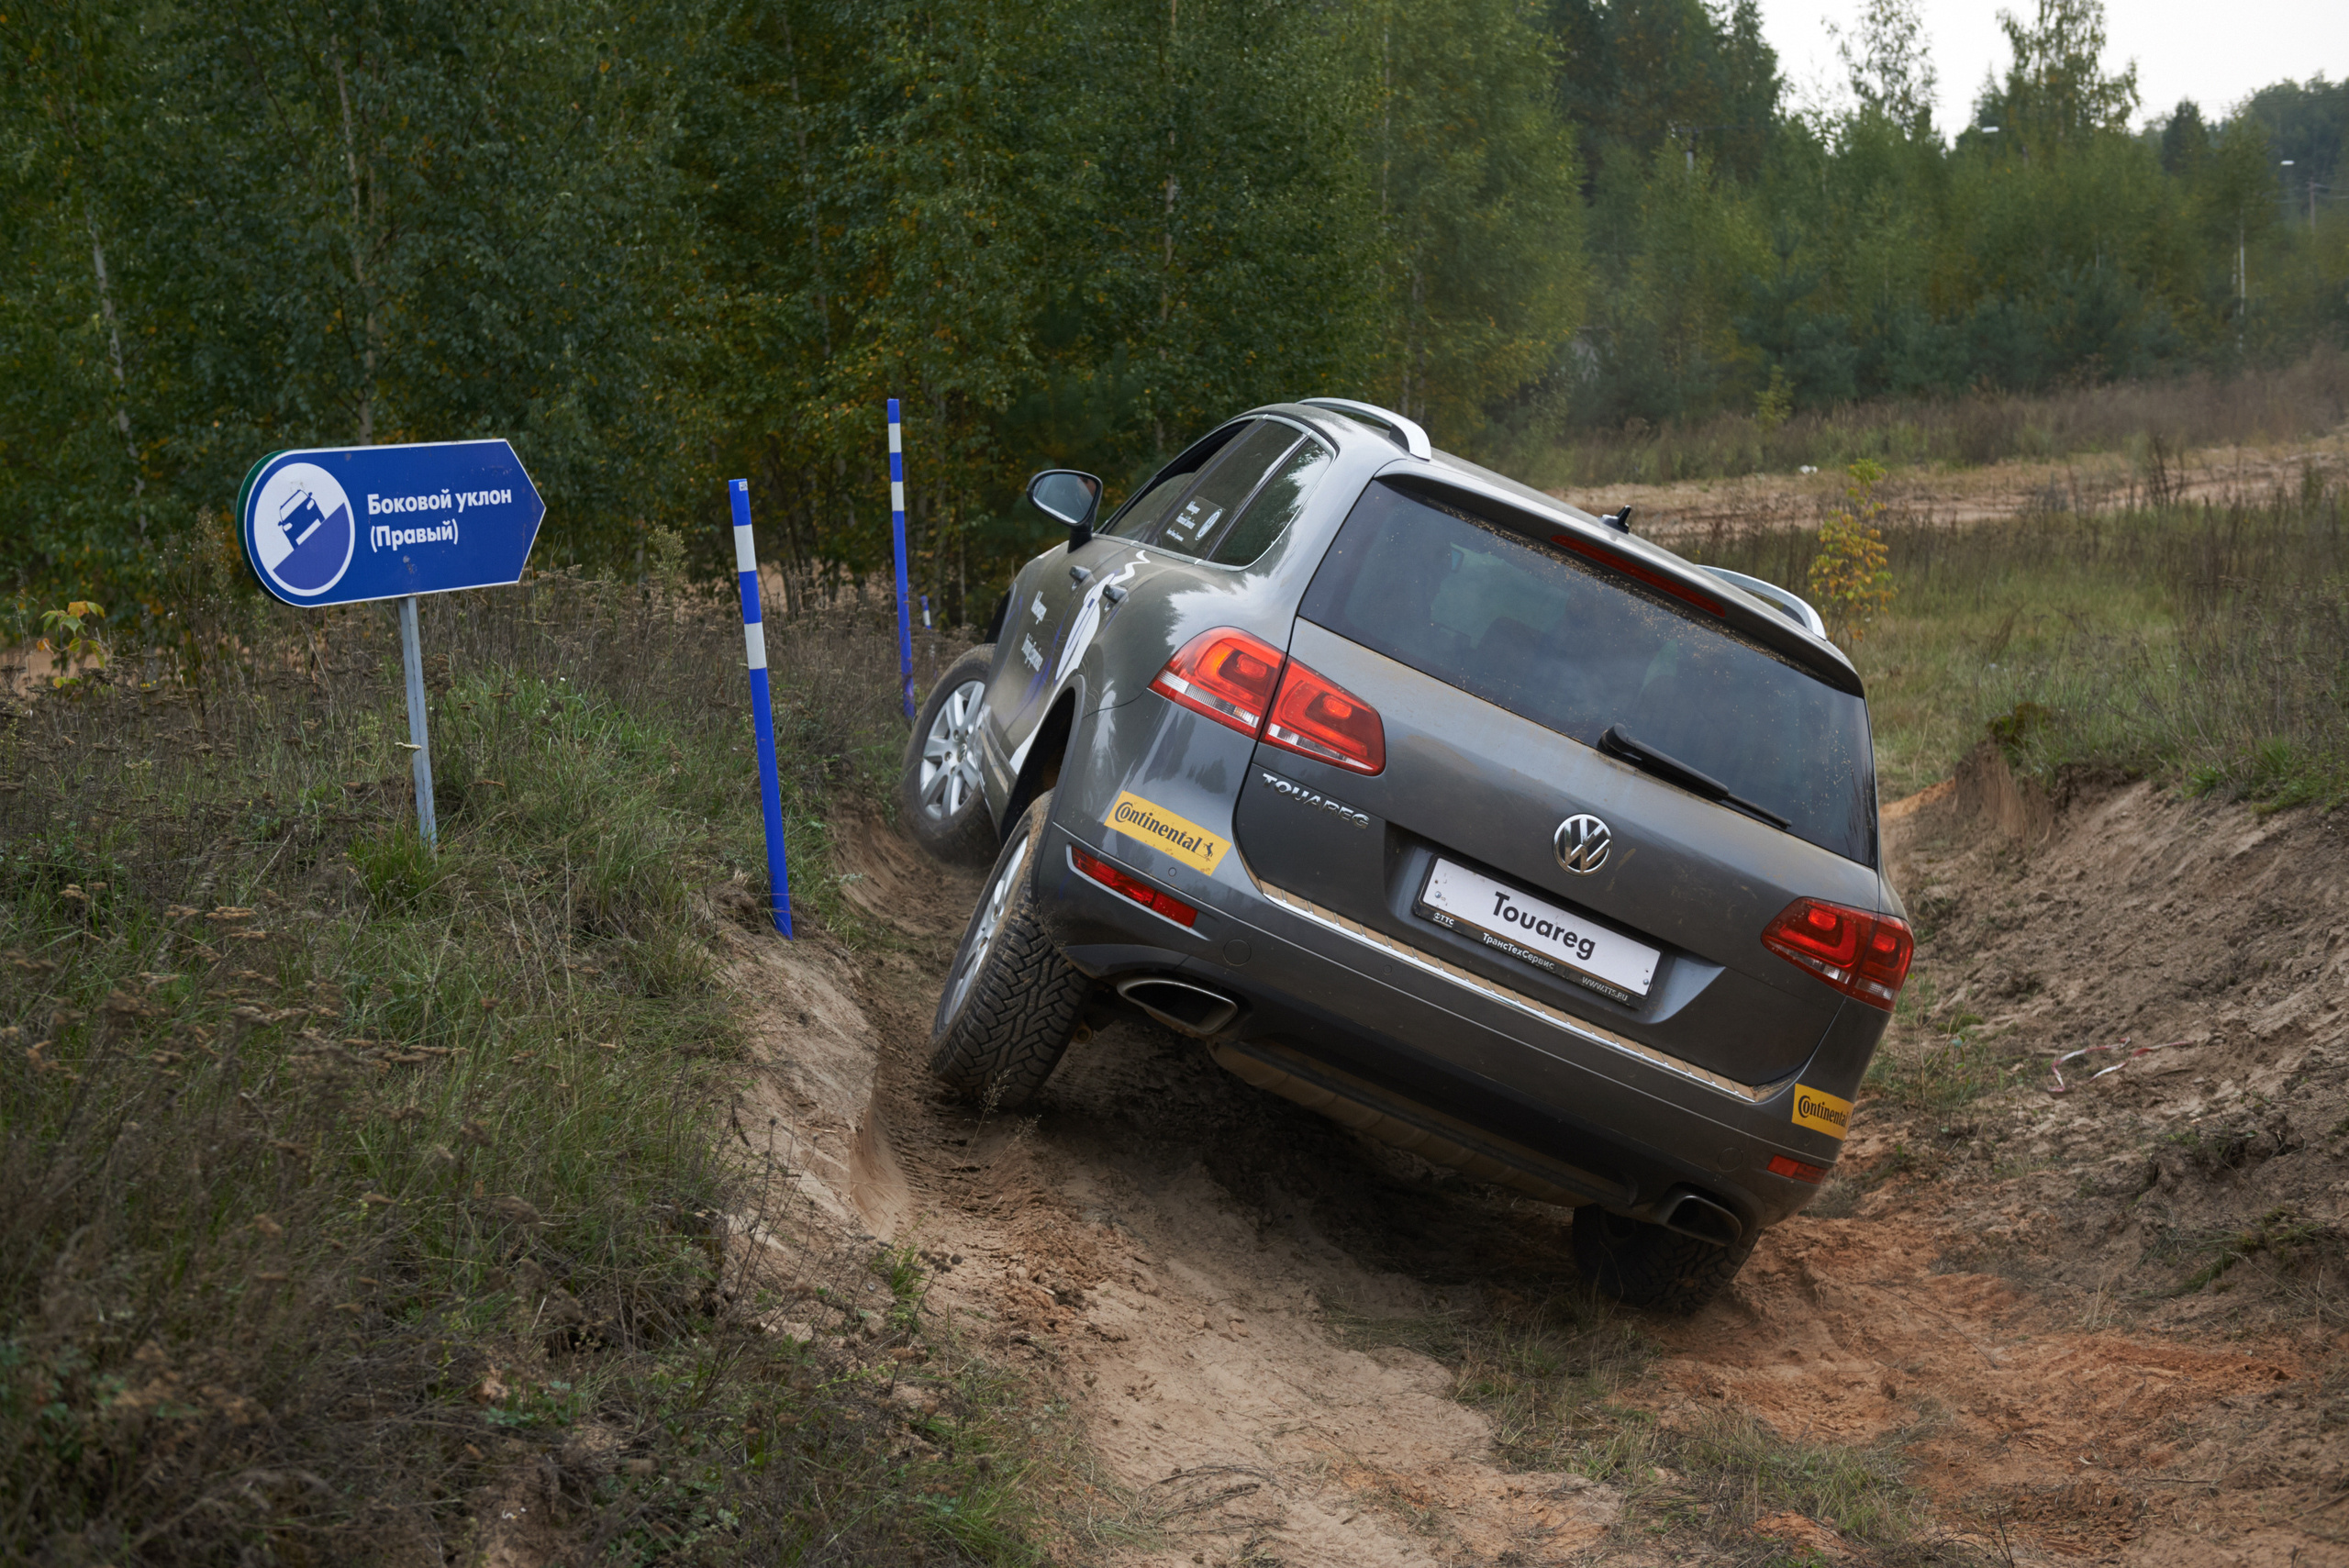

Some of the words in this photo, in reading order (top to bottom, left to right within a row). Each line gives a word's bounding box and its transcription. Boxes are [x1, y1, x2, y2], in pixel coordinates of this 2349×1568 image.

[367, 488, 451, 515] Боковой
[455, 489, 512, 513] уклон
[370, 518, 459, 552] (Правый)
[1263, 773, 1371, 830] TOUAREG
[1115, 801, 1203, 853] Continental
[1492, 891, 1597, 961] Touareg
[1482, 932, 1555, 971] ТрансТехСервис
